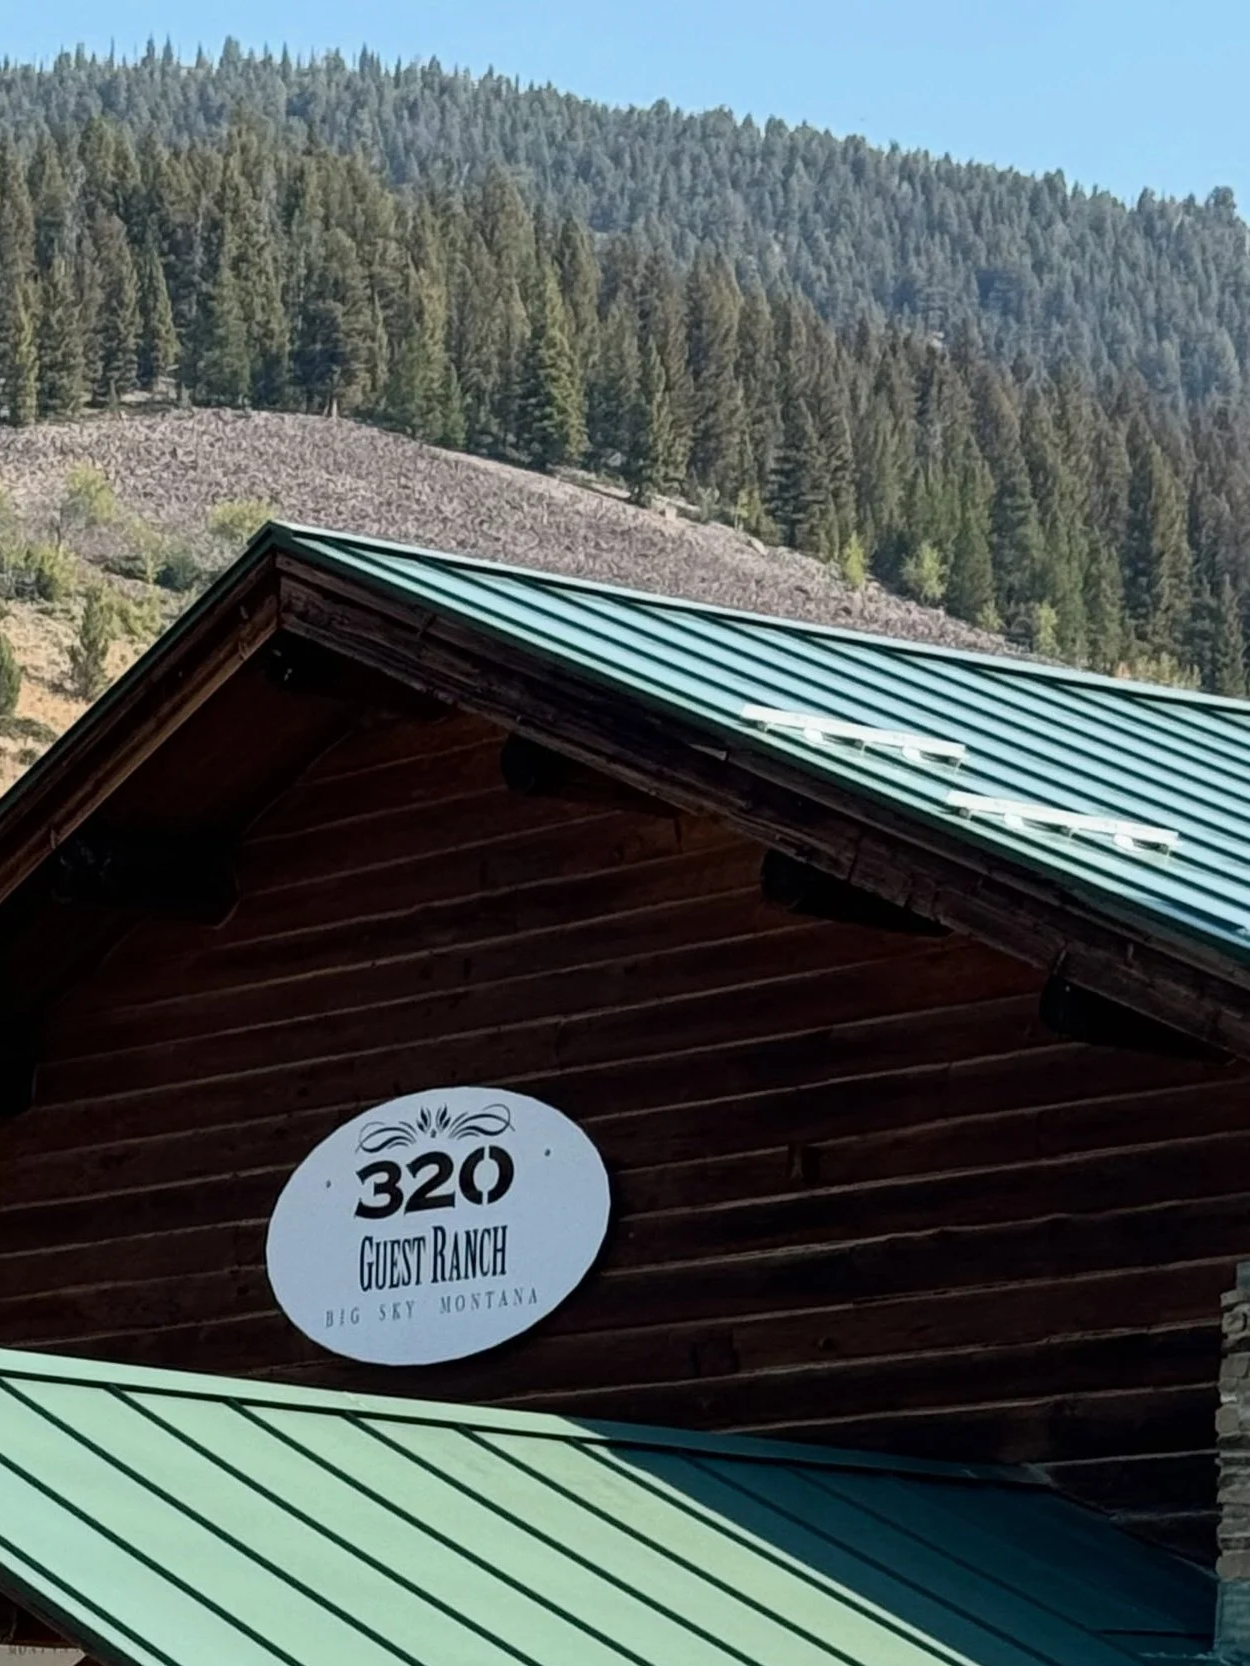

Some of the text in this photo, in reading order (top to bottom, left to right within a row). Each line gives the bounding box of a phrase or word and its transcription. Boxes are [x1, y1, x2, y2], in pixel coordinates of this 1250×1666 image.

[354, 1145, 515, 1220] 320
[359, 1225, 508, 1292] GUEST RANCH
[325, 1286, 539, 1328] BIG SKY MONTANA
